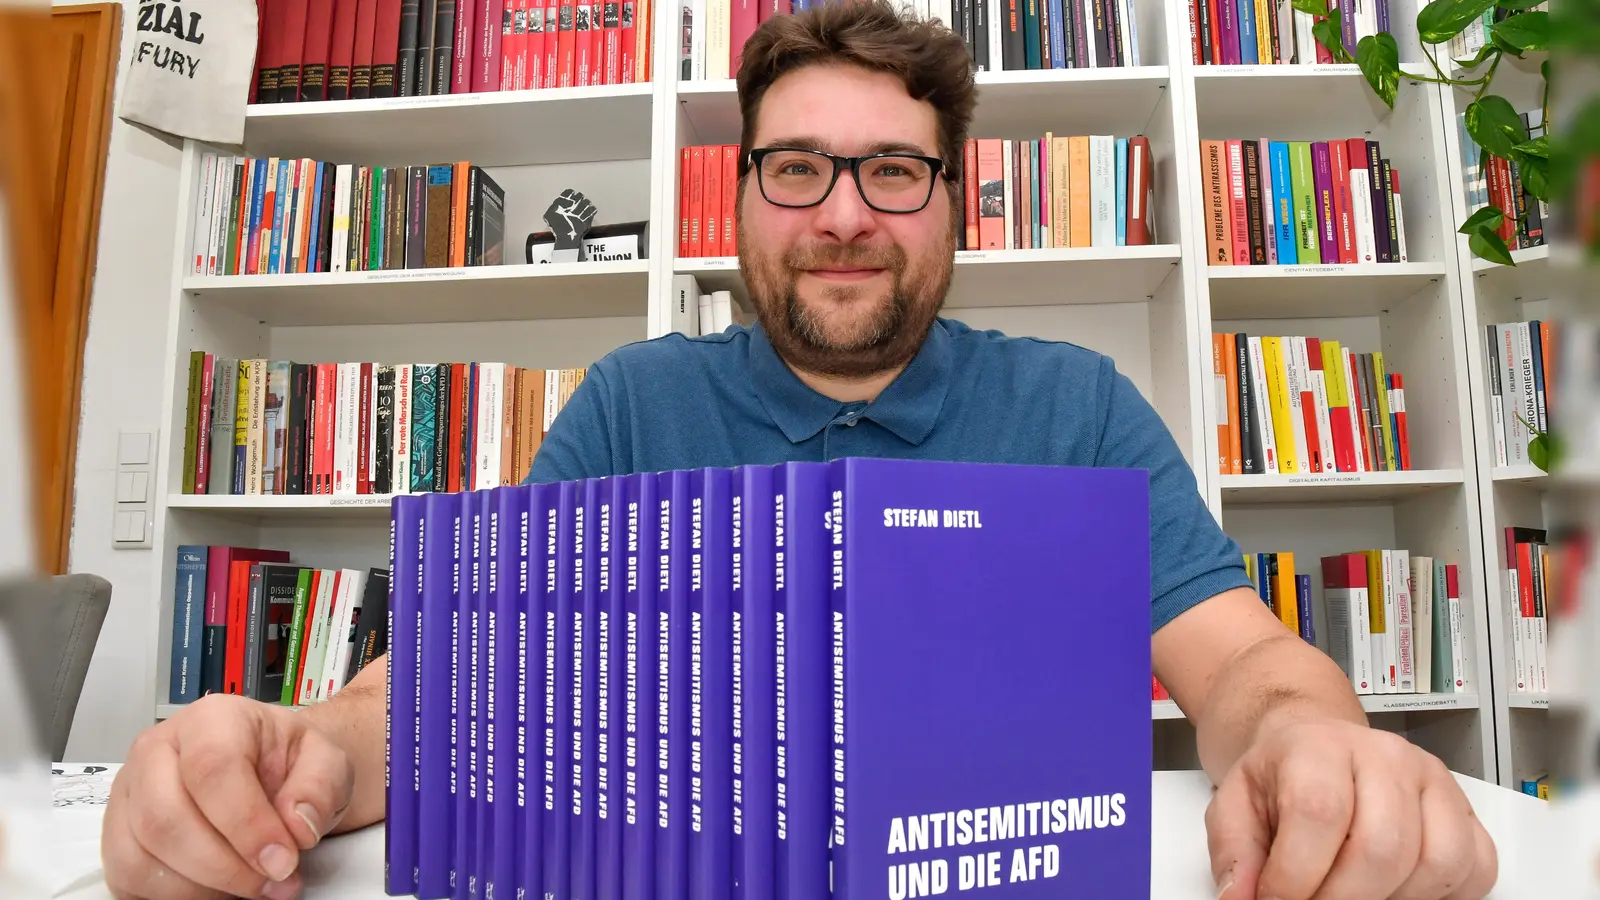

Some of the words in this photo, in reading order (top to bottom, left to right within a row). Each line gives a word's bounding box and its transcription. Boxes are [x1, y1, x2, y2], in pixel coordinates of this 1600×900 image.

[137, 3, 204, 45] ZIAL
[137, 42, 201, 79] FURY
[1210, 145, 1221, 195] ANTIRASSISMUS
[1230, 145, 1241, 175] LAIZISMUS
[1246, 146, 1256, 167] DIVERSITÄT
[1232, 175, 1242, 187] DES
[1233, 187, 1244, 199] LOB
[1248, 174, 1257, 188] TRUBEL
[1249, 188, 1258, 198] DER
[1213, 195, 1221, 208] DES
[1305, 195, 1313, 229] METAPHER
[1323, 190, 1333, 241] BEISSREFLEXE
[691, 217, 700, 244] SARTRE
[707, 217, 716, 243] SARTRE
[724, 217, 732, 244] SARTRE
[1215, 208, 1224, 241] PROBLEME
[1280, 198, 1290, 241] IRRWEGE
[1342, 212, 1351, 251] FEMINISTISCH
[586, 244, 606, 254] THE
[1301, 221, 1309, 249] FREIHEIT
[1307, 230, 1315, 249] KEINE
[593, 253, 632, 262] UNION
[412, 271, 466, 279] ARBEITERBEWEGUNG
[400, 367, 409, 384] Rom
[1287, 363, 1297, 408] AUTOMATISIERUNG
[1292, 368, 1301, 400] AUSBEUTUNG
[1508, 368, 1516, 393] FEHLENDER
[253, 385, 261, 419] Entstehung
[399, 385, 408, 398] auf
[1522, 358, 1536, 435] CORONA-KRIEGER
[398, 399, 408, 426] Marsch
[398, 426, 407, 441] rote
[436, 401, 447, 457] Gründungsparteitages
[250, 439, 259, 476] Wohlgemuth
[397, 442, 406, 455] Der
[435, 468, 443, 491] Protokoll
[547, 508, 557, 555] STEFAN
[574, 506, 584, 554] STEFAN
[601, 503, 610, 553] STEFAN
[628, 502, 638, 552] STEFAN
[660, 500, 670, 550] STEFAN
[692, 498, 702, 549] STEFAN
[732, 496, 742, 548] STEFAN
[775, 494, 785, 547] STEFAN
[832, 490, 843, 545] STEFAN
[883, 508, 939, 529] STEFAN
[943, 509, 983, 529] DIETL
[520, 511, 528, 556] STEFAN
[546, 559, 556, 594] DIETL
[574, 558, 583, 594] DIETL
[600, 557, 609, 593] DIETL
[627, 556, 637, 593] DIETL
[659, 555, 669, 593] DIETL
[692, 553, 702, 592] DIETL
[732, 552, 742, 592] DIETL
[775, 551, 785, 592] DIETL
[833, 549, 844, 591] DIETL
[185, 573, 193, 602] Opposition
[296, 587, 305, 604] August
[293, 604, 303, 630] Thalheimer
[1399, 594, 1408, 624] Parasiten
[289, 640, 298, 658] German
[366, 629, 377, 656] HINAUS
[1401, 628, 1409, 646] Pöbel
[285, 658, 295, 686] Communism
[487, 611, 496, 720] ANTISEMITISMUS
[518, 612, 527, 723] ANTISEMITISMUS
[545, 612, 555, 725] ANTISEMITISMUS
[573, 612, 583, 728] ANTISEMITISMUS
[599, 611, 608, 730] ANTISEMITISMUS
[626, 612, 637, 733] ANTISEMITISMUS
[658, 612, 669, 735] ANTISEMITISMUS
[691, 611, 702, 737] ANTISEMITISMUS
[732, 612, 742, 739] ANTISEMITISMUS
[1402, 647, 1411, 675] Proleten
[775, 612, 786, 742] ANTISEMITISMUS
[833, 611, 845, 745] ANTISEMITISMUS
[1383, 699, 1458, 708] KLASSENPOLITIKDEBATTE
[517, 727, 526, 755] UND
[545, 728, 554, 757] UND
[573, 731, 582, 761] UND
[598, 733, 608, 764] UND
[626, 737, 636, 768] UND
[658, 739, 669, 770] UND
[517, 758, 525, 780] DIE
[545, 761, 554, 782] DIE
[691, 740, 701, 773] UND
[733, 742, 742, 775] UND
[776, 745, 786, 779] UND
[834, 748, 845, 783] UND
[486, 779, 494, 803] AFD
[573, 765, 582, 787] DIE
[598, 767, 608, 791] DIE
[626, 771, 636, 796] DIE
[658, 773, 669, 798] DIE
[691, 776, 701, 801] DIE
[517, 782, 525, 807] AFD
[545, 785, 554, 811] AFD
[572, 789, 581, 816] AFD
[598, 793, 608, 820] AFD
[733, 779, 742, 805] DIE
[777, 783, 787, 809] DIE
[834, 786, 845, 814] DIE
[626, 798, 636, 825] AFD
[659, 801, 669, 829] AFD
[691, 804, 702, 833] AFD
[733, 807, 743, 836] AFD
[777, 811, 787, 841] AFD
[887, 793, 1126, 854] ANTISEMITISMUS
[834, 816, 846, 846] AFD
[888, 856, 949, 900] UND
[958, 853, 1001, 890] DIE
[1009, 844, 1060, 883] AFD
